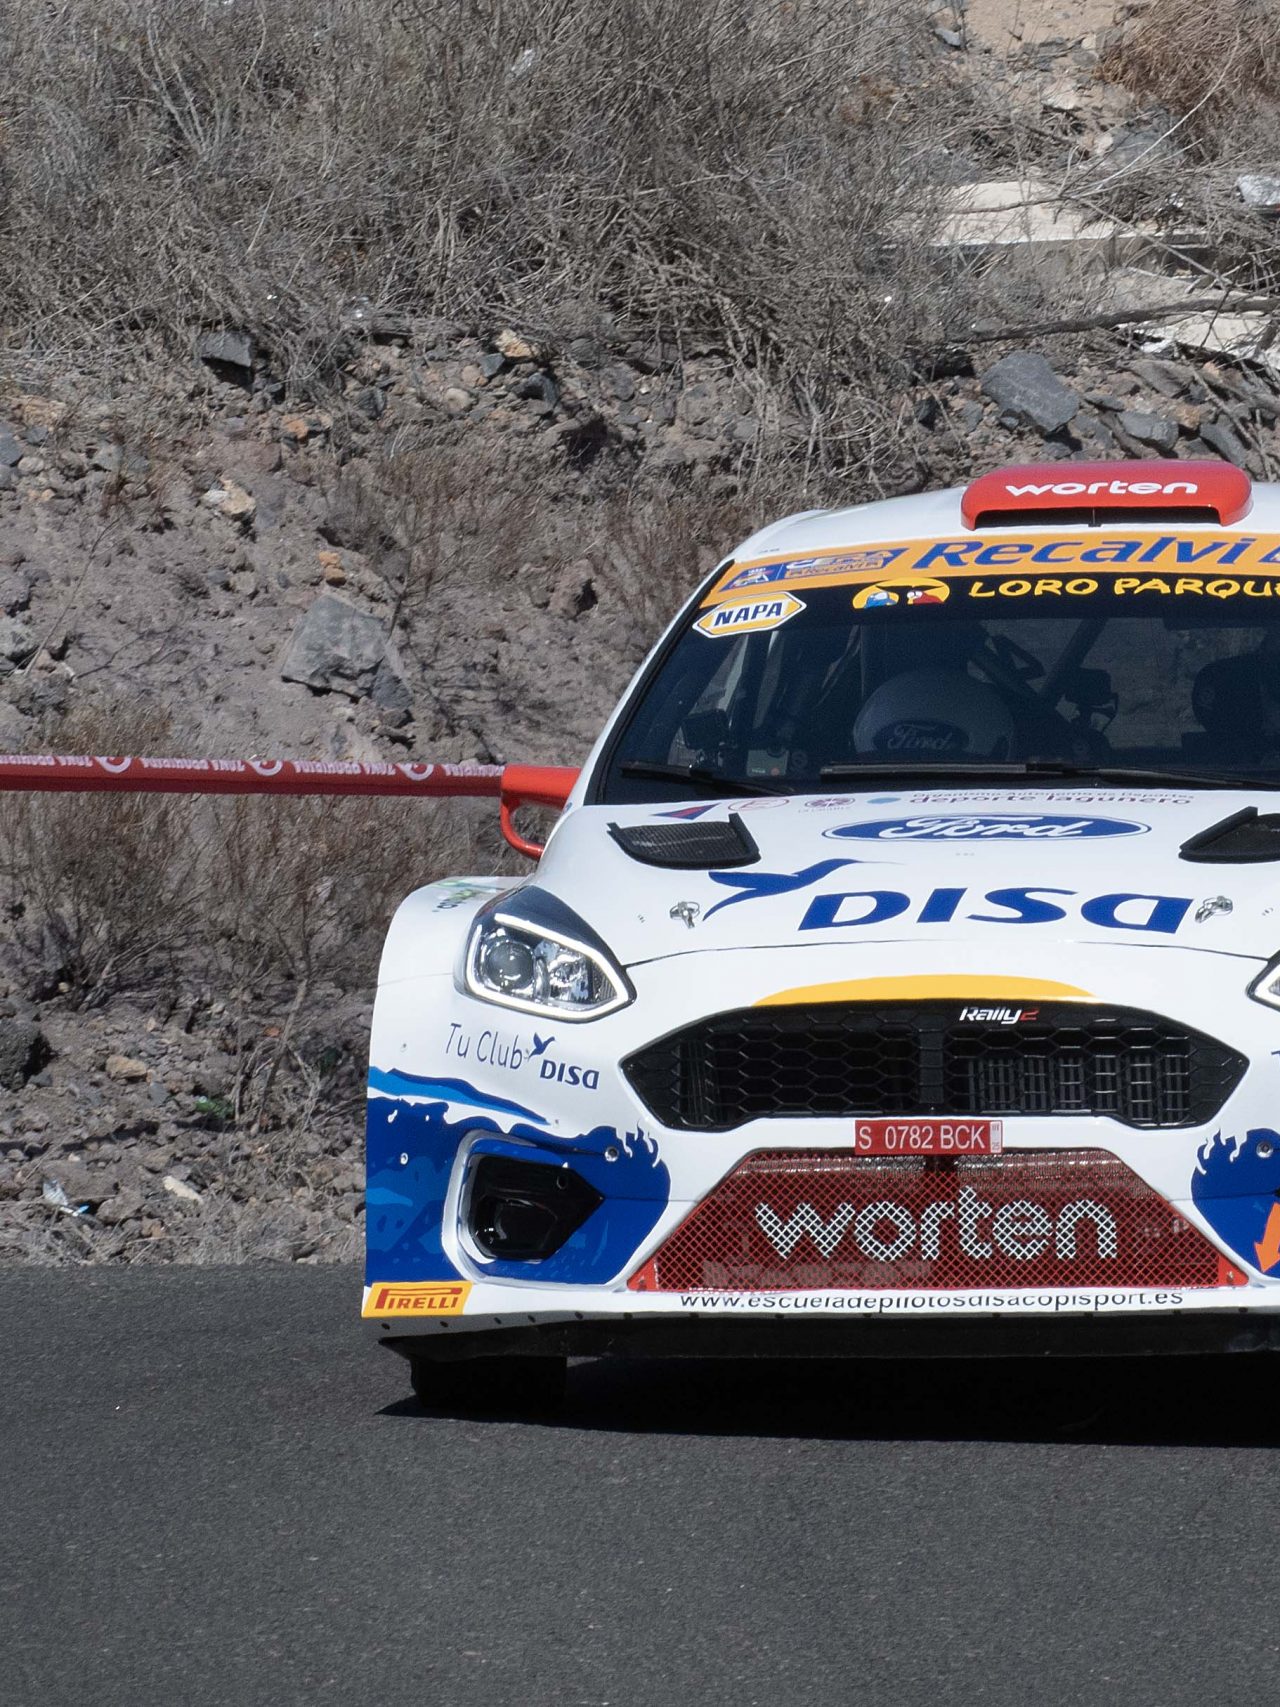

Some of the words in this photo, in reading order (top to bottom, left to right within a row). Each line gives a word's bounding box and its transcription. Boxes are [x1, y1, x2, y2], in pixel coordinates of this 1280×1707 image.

[1005, 480, 1198, 497] worten
[911, 536, 1256, 570] Recalvi
[968, 578, 1098, 598] LORO
[714, 601, 785, 627] NAPA
[878, 815, 1090, 838] Ford
[959, 1006, 1040, 1025] Rally2
[446, 1023, 472, 1057] Tu
[476, 1031, 524, 1070] Club
[859, 1126, 872, 1150] S
[885, 1125, 934, 1149] 0782
[940, 1125, 986, 1149] BCK
[754, 1185, 1118, 1262] worten
[375, 1287, 463, 1310] PIRELLI
